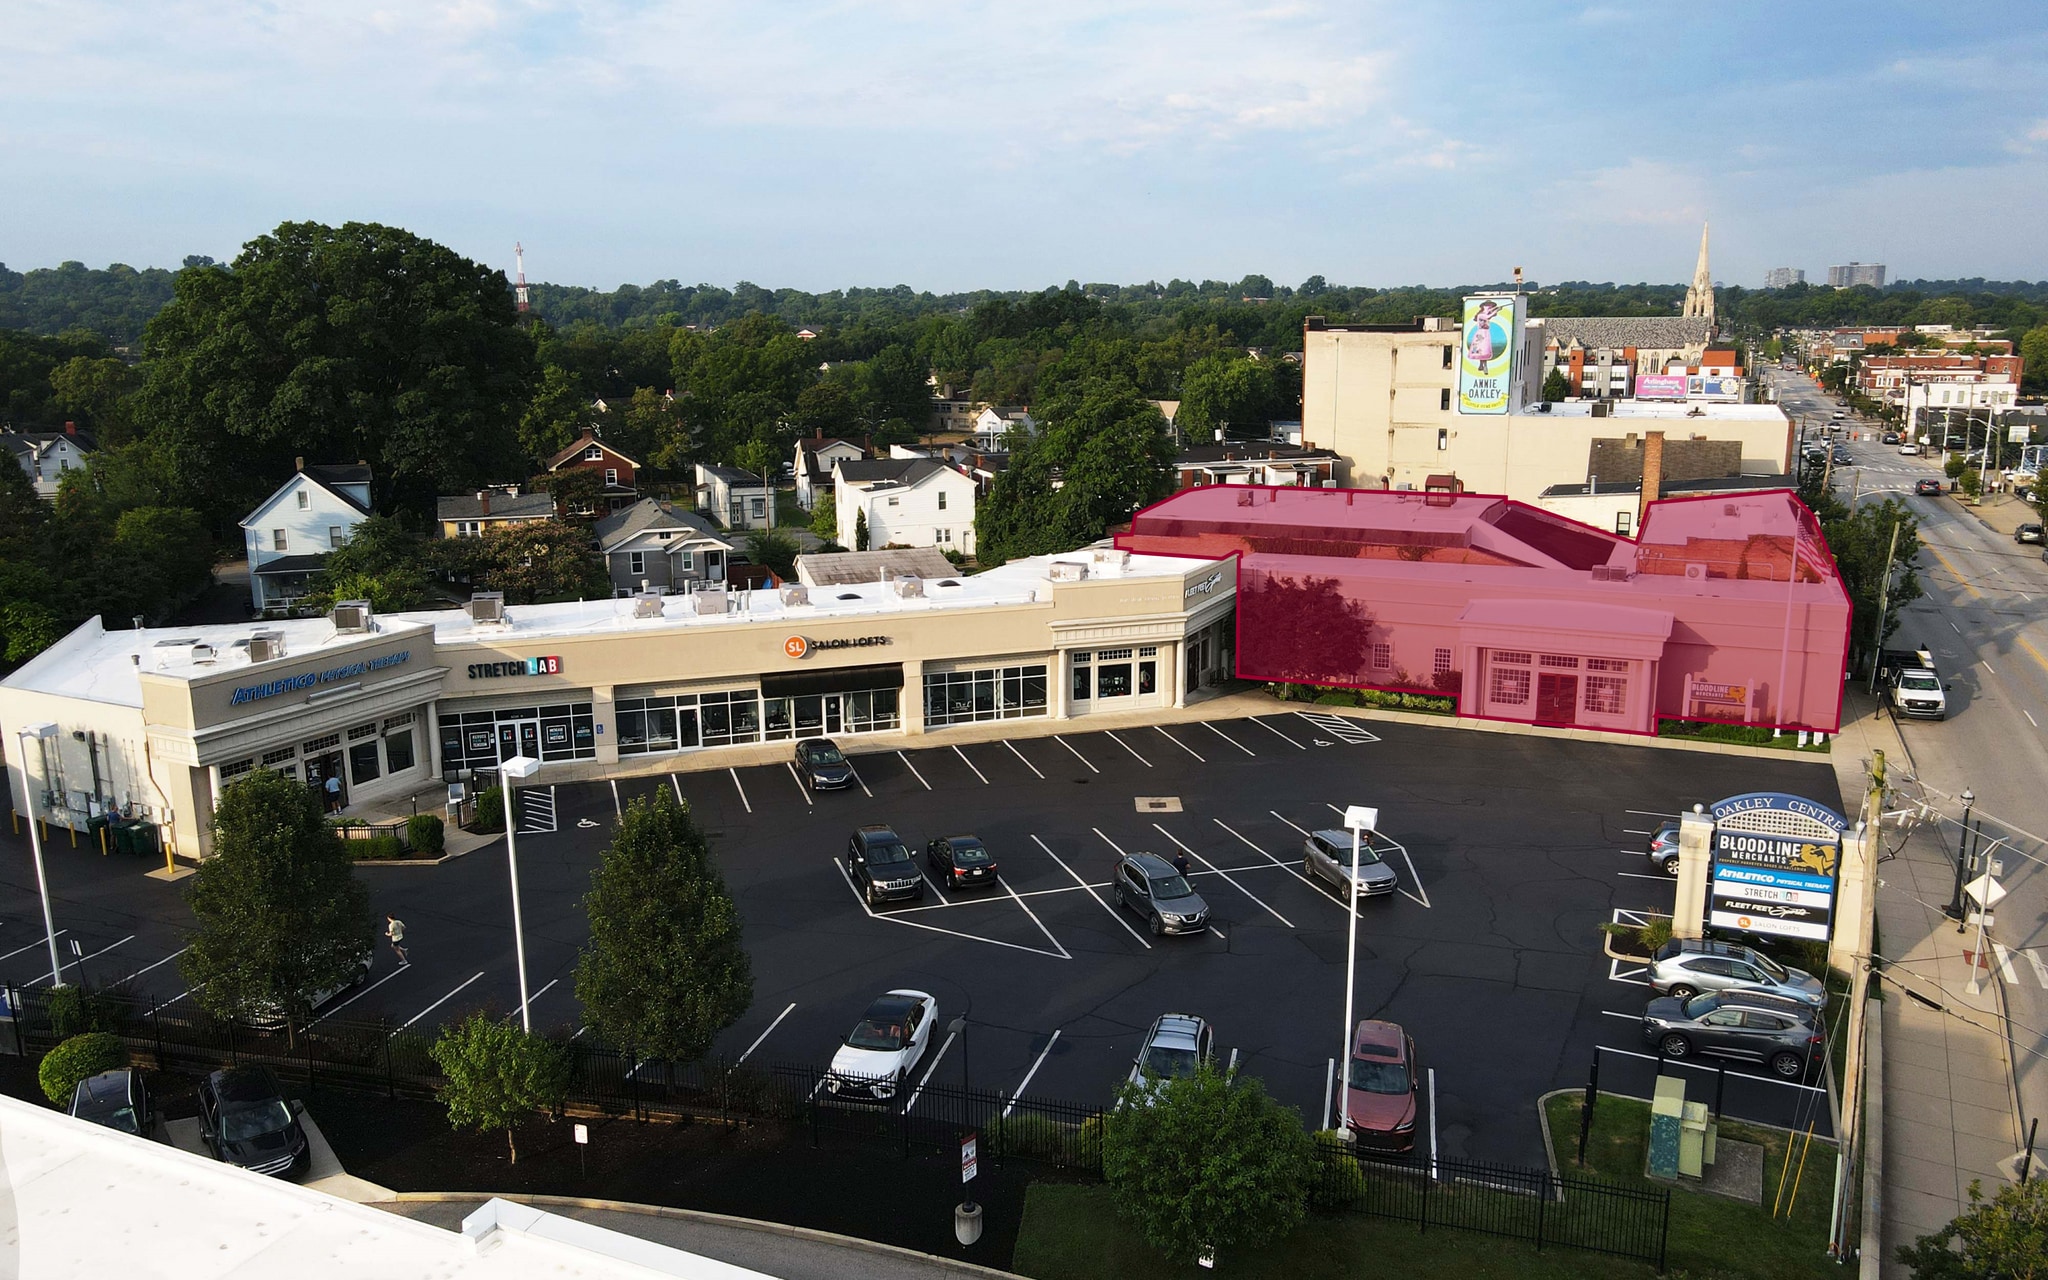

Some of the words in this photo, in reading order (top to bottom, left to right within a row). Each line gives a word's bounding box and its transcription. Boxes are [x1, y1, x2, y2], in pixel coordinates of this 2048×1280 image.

[1473, 379, 1497, 388] ANNIE
[1468, 389, 1501, 398] OAKLEY
[788, 641, 803, 653] SL
[811, 638, 849, 650] SALON
[853, 635, 887, 647] LOFTS
[230, 672, 317, 706] ATHLETICO
[320, 662, 368, 684] PHYSICAL
[369, 650, 412, 671] THERAPY
[1692, 684, 1729, 693] BLOODLINE
[1715, 798, 1773, 817] OAKLEY
[1788, 800, 1844, 831] CENTRE
[1719, 835, 1801, 857] BLOODLINE
[1731, 851, 1787, 865] MERCHANTS
[1718, 868, 1775, 884] ATHLETICO
[1776, 878, 1803, 887] PHYSICAL
[1804, 881, 1831, 890] THERAPY
[1725, 901, 1751, 909] FLEET
[1751, 904, 1772, 912] FEET
[1754, 920, 1777, 929] SALON
[1779, 923, 1800, 932] LOFTS
